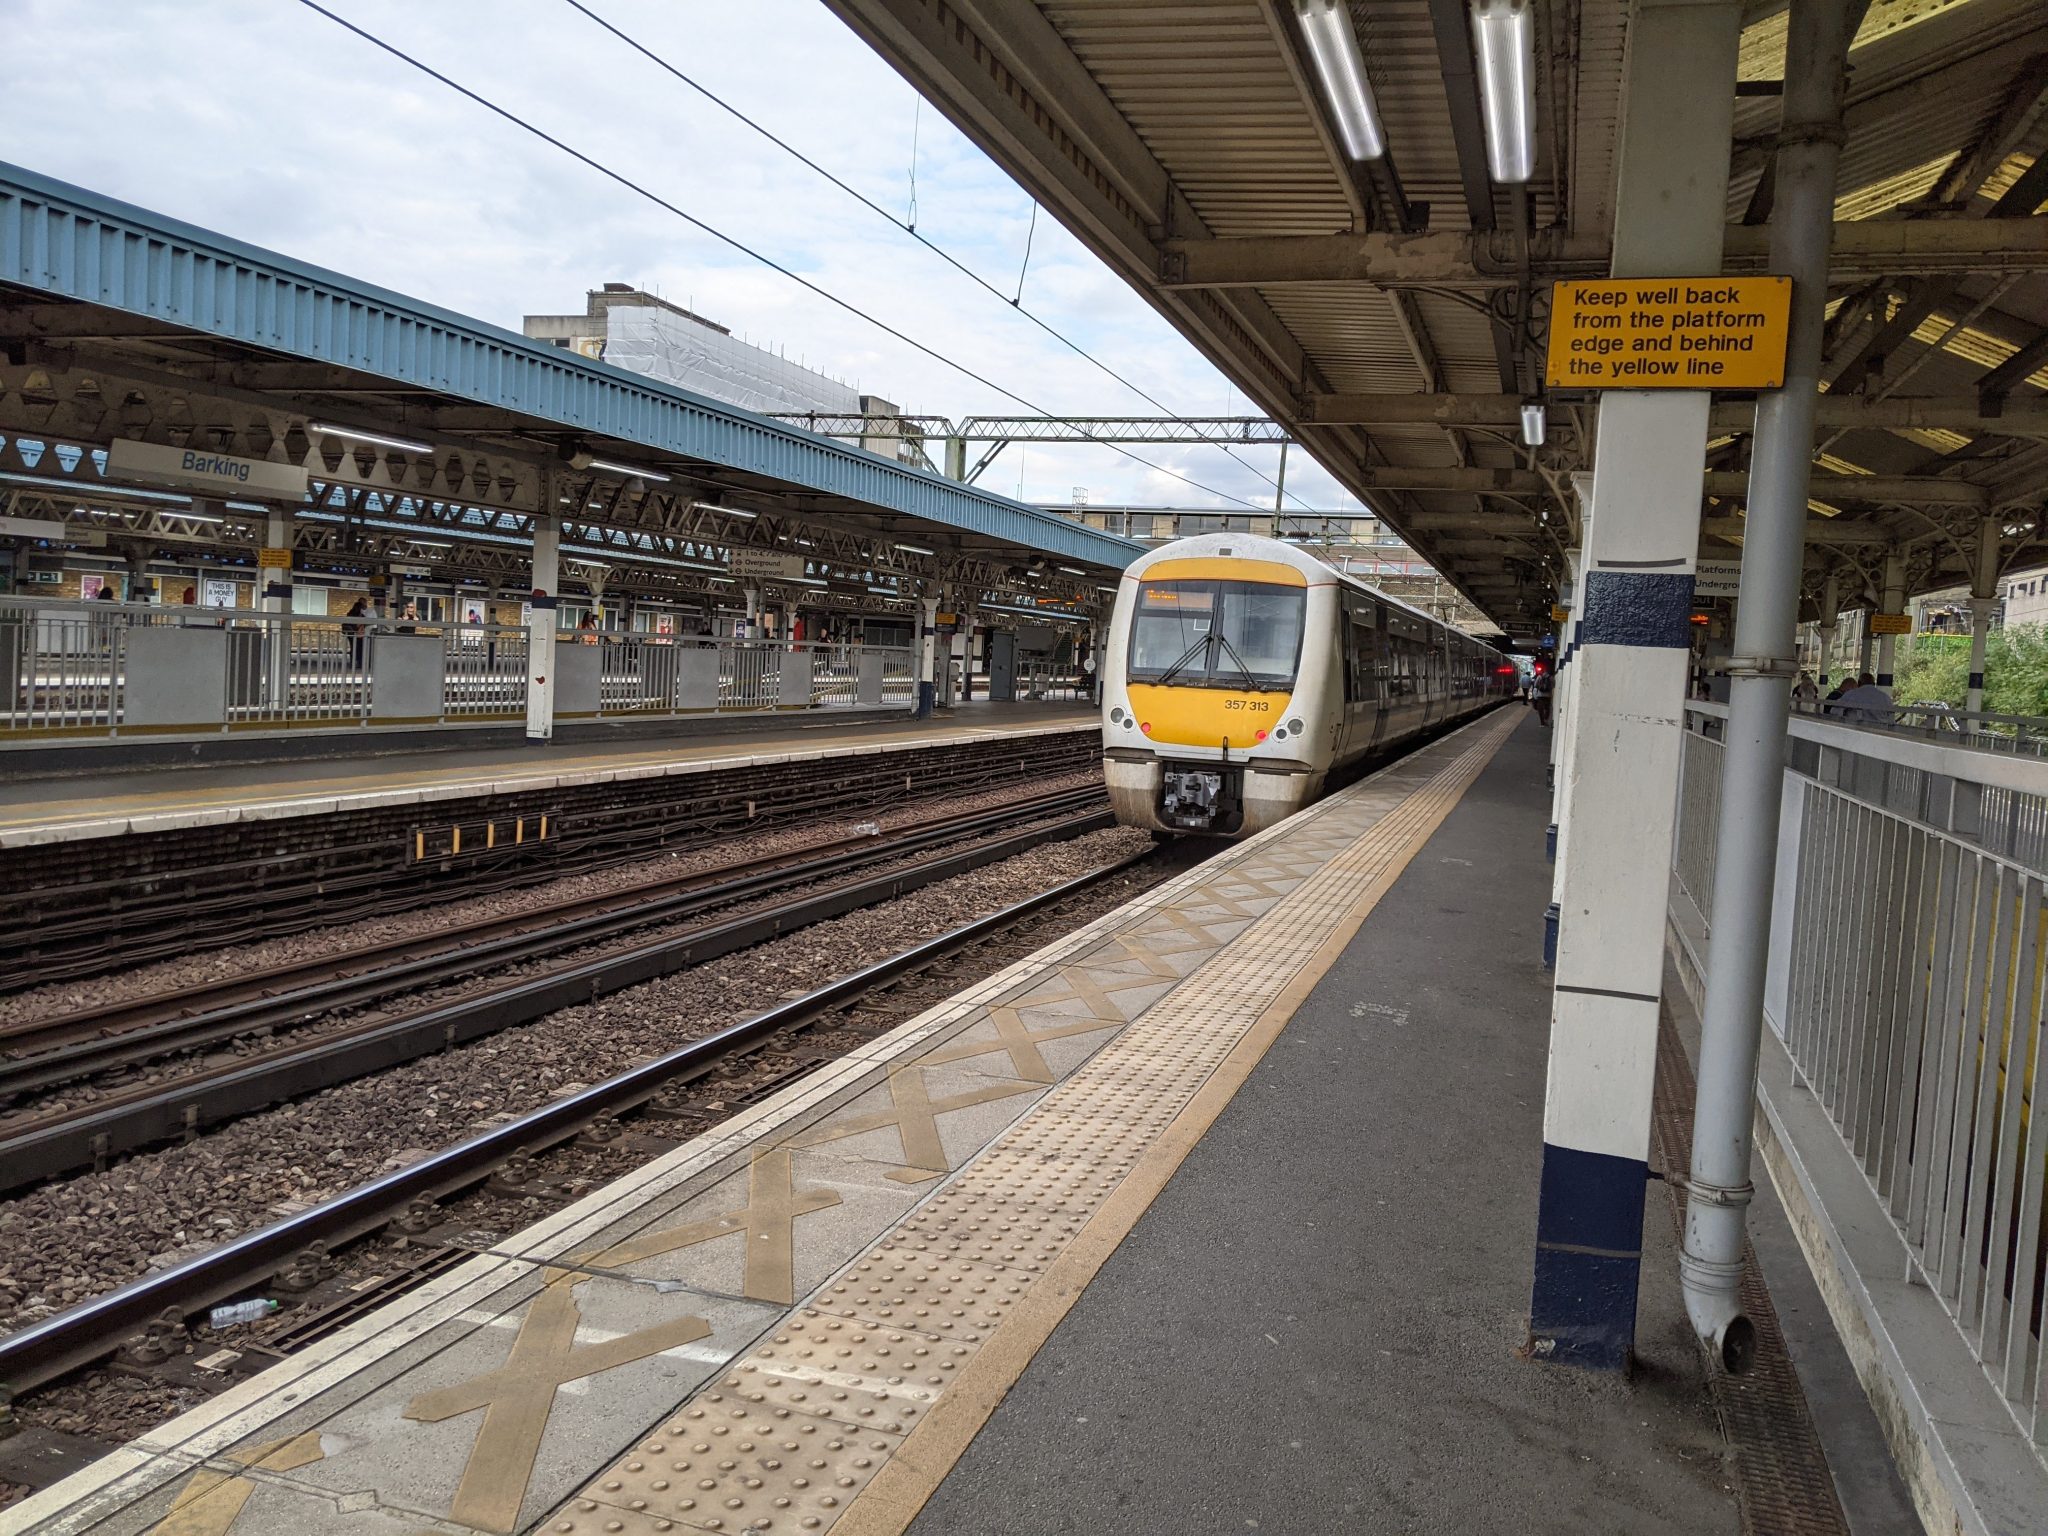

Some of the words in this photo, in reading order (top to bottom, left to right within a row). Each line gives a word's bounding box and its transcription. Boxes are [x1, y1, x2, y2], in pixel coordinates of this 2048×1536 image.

[1574, 289, 1627, 308] Keep
[1637, 287, 1678, 304] well
[1685, 287, 1740, 304] back
[1573, 312, 1622, 328] from
[1630, 311, 1664, 328] the
[1672, 310, 1766, 331] platform
[1570, 335, 1624, 354] edge
[1632, 334, 1672, 351] and
[1680, 334, 1753, 351] behind
[1569, 358, 1603, 375] the
[1611, 357, 1679, 378] yellow
[1687, 357, 1724, 374] line
[182, 451, 250, 481] Barking
[745, 559, 781, 567] Overground
[744, 568, 784, 576] Underground
[211, 582, 225, 590] THIS
[901, 581, 910, 594] 5
[213, 589, 235, 597] MONEY
[1225, 699, 1247, 711] 357
[1249, 701, 1269, 712] 313
